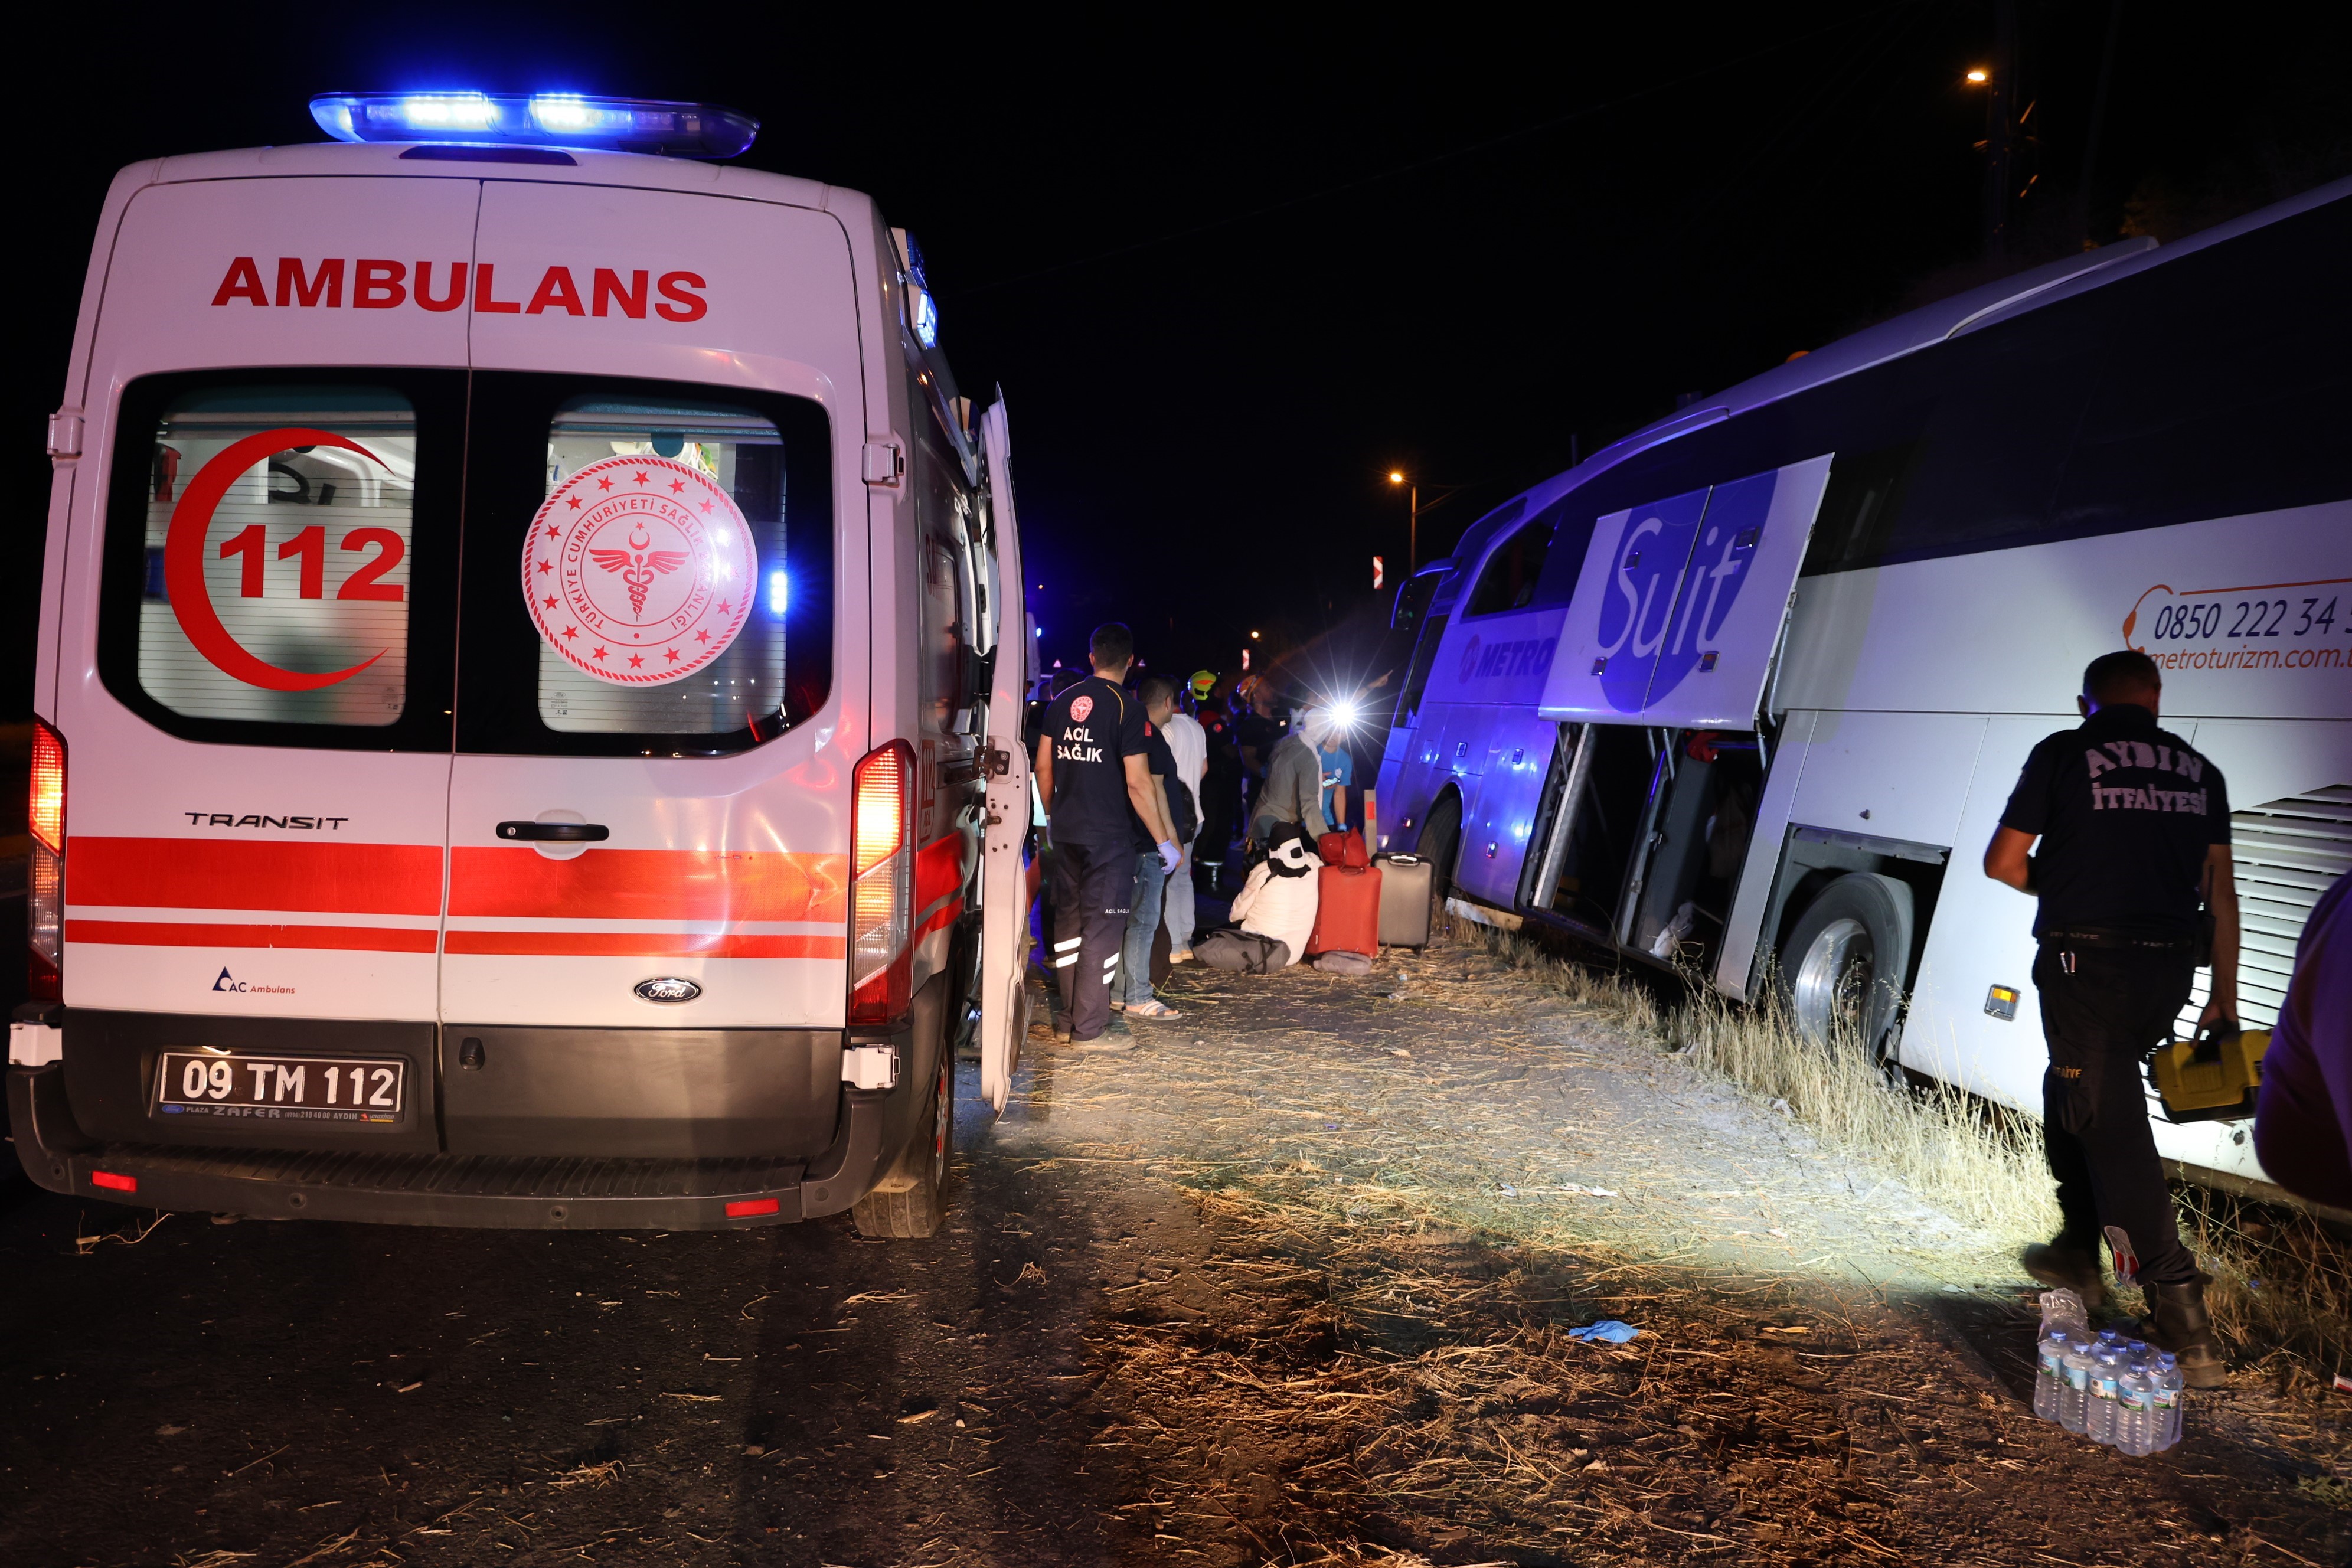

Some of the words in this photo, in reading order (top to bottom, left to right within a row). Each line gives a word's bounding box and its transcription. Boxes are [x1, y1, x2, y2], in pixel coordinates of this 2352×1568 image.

[211, 256, 708, 322] AMBULANS
[567, 498, 655, 563] CUMHURİYETİ
[659, 504, 704, 547] SAĞLIK
[220, 524, 405, 602] 112
[567, 569, 605, 629] TÜRKİYE
[1600, 517, 1742, 660] Suit
[2154, 602, 2222, 640] 0850
[2227, 599, 2288, 638] 222
[2292, 595, 2338, 636] 34
[1475, 636, 1556, 678] METRO
[2085, 741, 2204, 783] AYDIN
[2092, 782, 2207, 816] İTFAİYESİ
[185, 812, 350, 831] TRANSIT
[250, 985, 296, 995] Ambulans
[648, 982, 687, 998] Ford
[182, 1059, 233, 1100] 09
[246, 1063, 306, 1103] TM
[324, 1066, 395, 1106] 112
[213, 1106, 280, 1119] ZAFER
[333, 1112, 357, 1121] AYDIN
